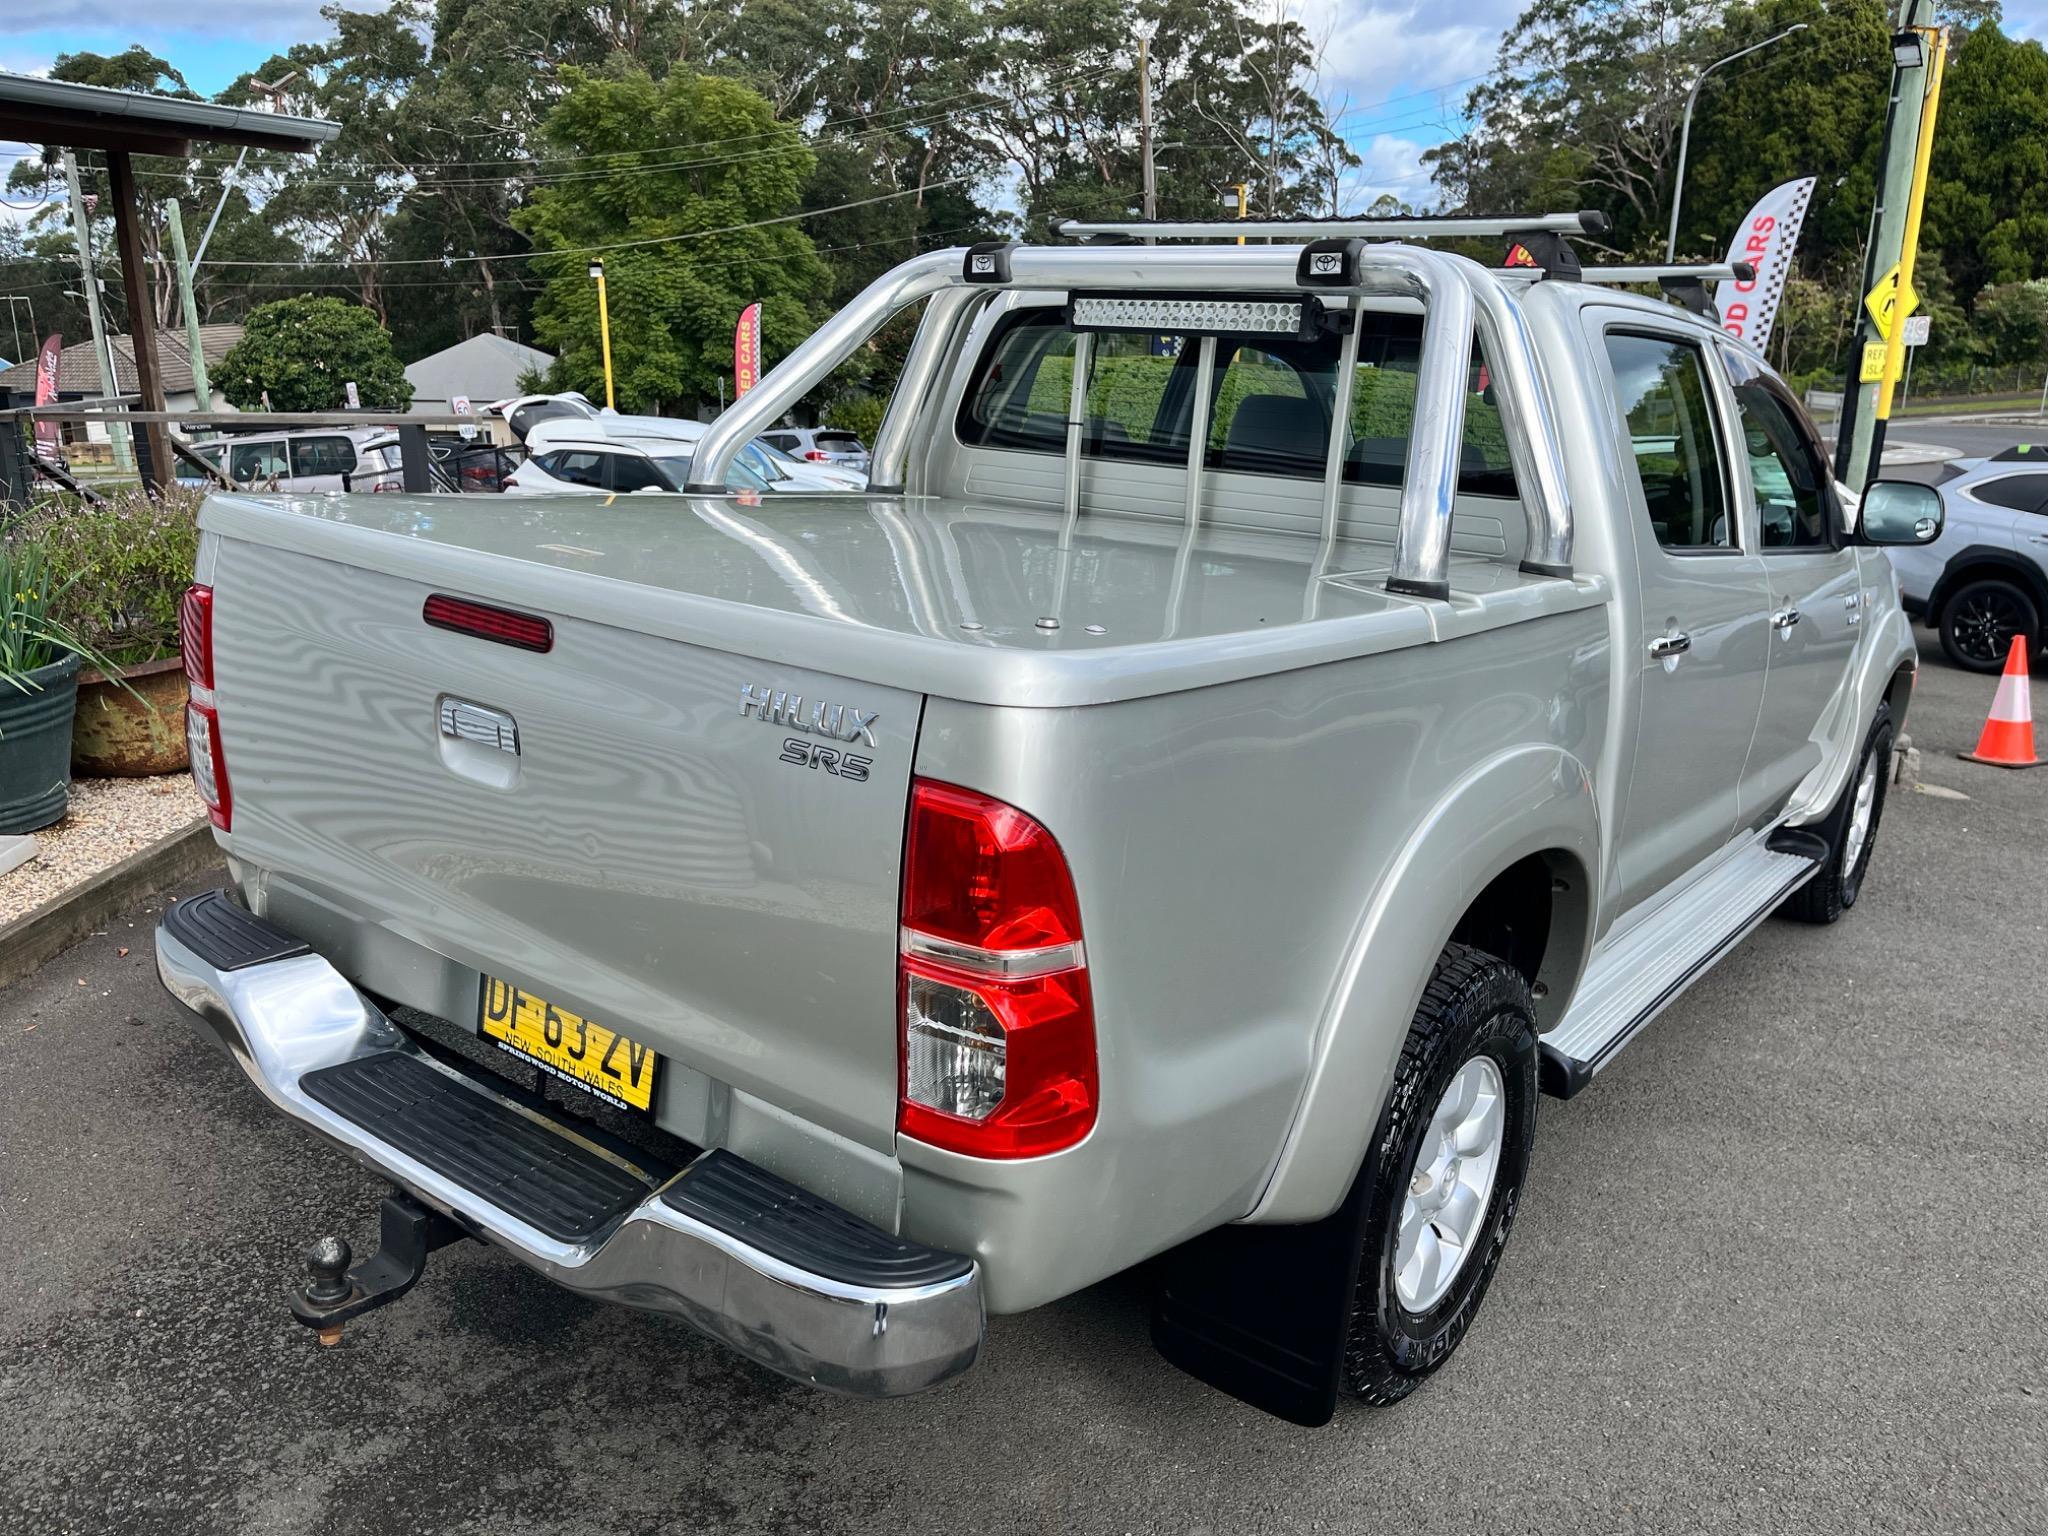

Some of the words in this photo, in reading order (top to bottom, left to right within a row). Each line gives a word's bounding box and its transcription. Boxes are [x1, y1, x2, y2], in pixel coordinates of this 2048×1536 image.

[1735, 215, 1775, 293] CARS
[741, 321, 751, 364] CARS
[739, 682, 880, 748] HILUX
[779, 738, 873, 782] SR5
[497, 1041, 557, 1076] SPRINGWOOD
[557, 1072, 592, 1093] MOTOR
[592, 1087, 628, 1110] WORLD
[505, 1030, 531, 1053] NEW
[535, 1046, 577, 1076] SOUTH
[583, 1067, 625, 1099] WALES
